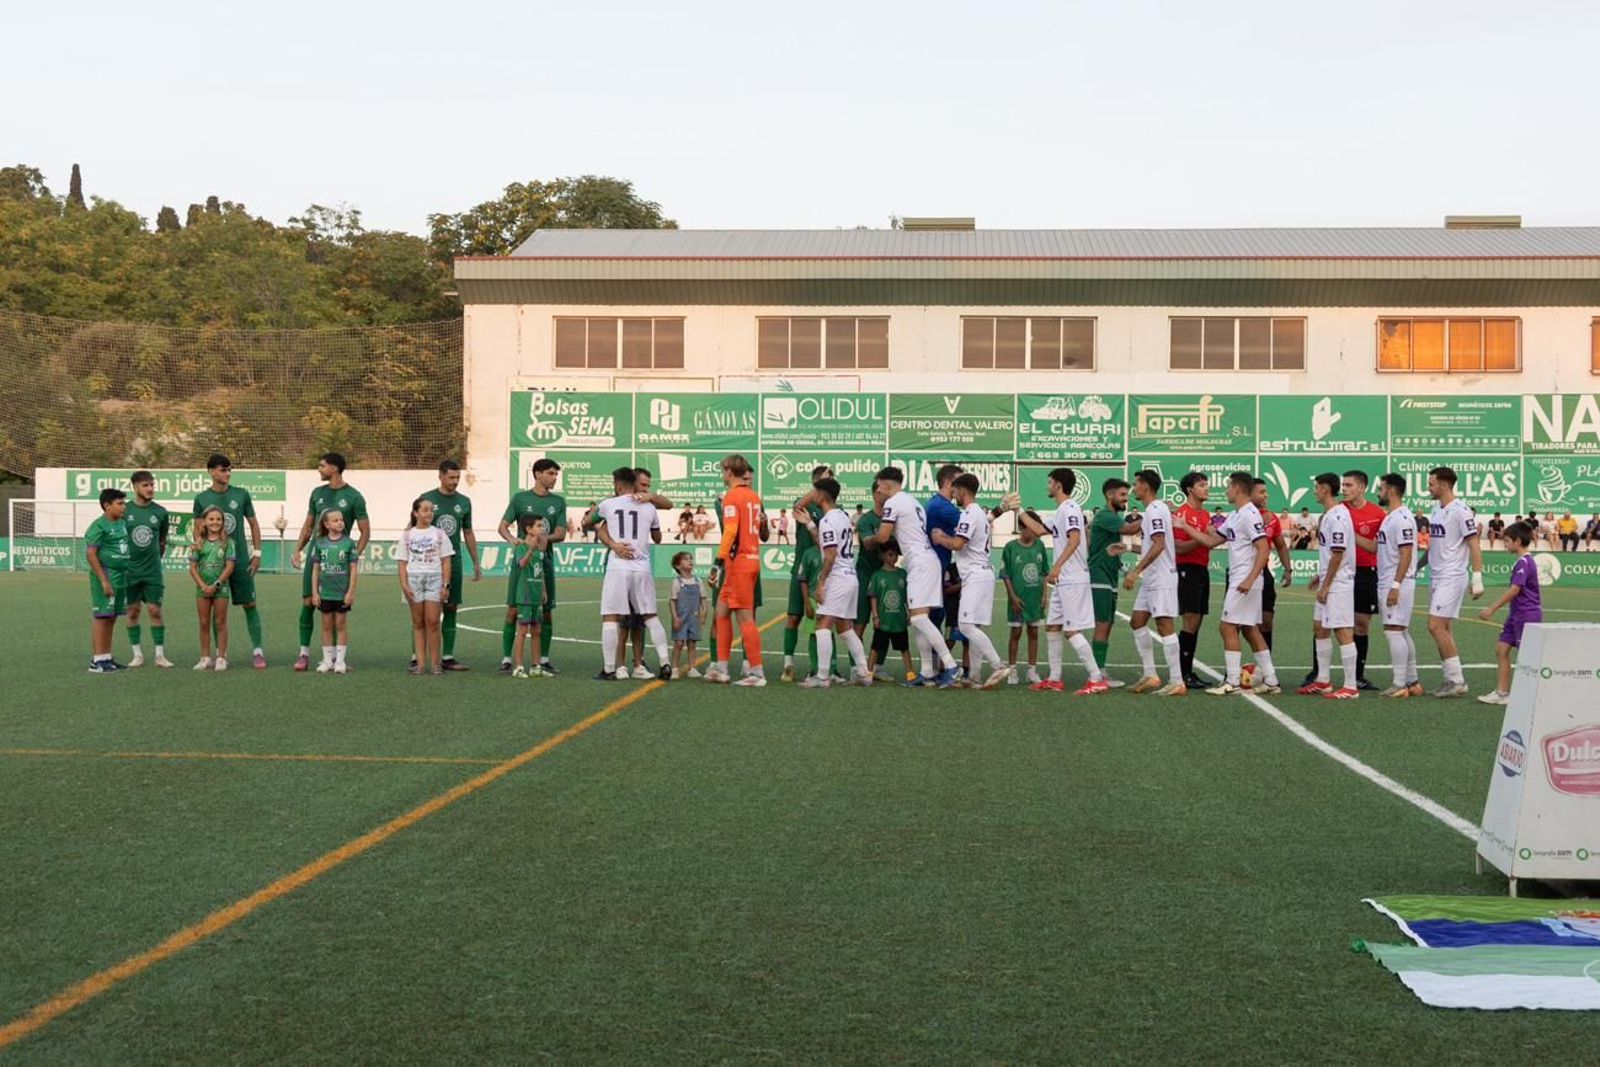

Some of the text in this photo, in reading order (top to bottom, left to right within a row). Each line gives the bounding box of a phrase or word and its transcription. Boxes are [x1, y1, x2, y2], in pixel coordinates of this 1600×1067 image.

[530, 392, 589, 416] Bolsas
[799, 397, 883, 420] OLIDUL
[569, 416, 614, 435] SEMA
[890, 420, 931, 430] CENTRO
[933, 420, 972, 430] DENTAL
[974, 420, 1013, 430] VALERO
[1019, 423, 1121, 435] EL CHURRI
[1531, 442, 1598, 450] TIRADORES PARA
[836, 459, 880, 476] pulido
[1189, 463, 1251, 472] Agroservicios
[1500, 498, 1511, 507] 67
[614, 509, 638, 541] 11
[24, 556, 56, 565] ZAFRA
